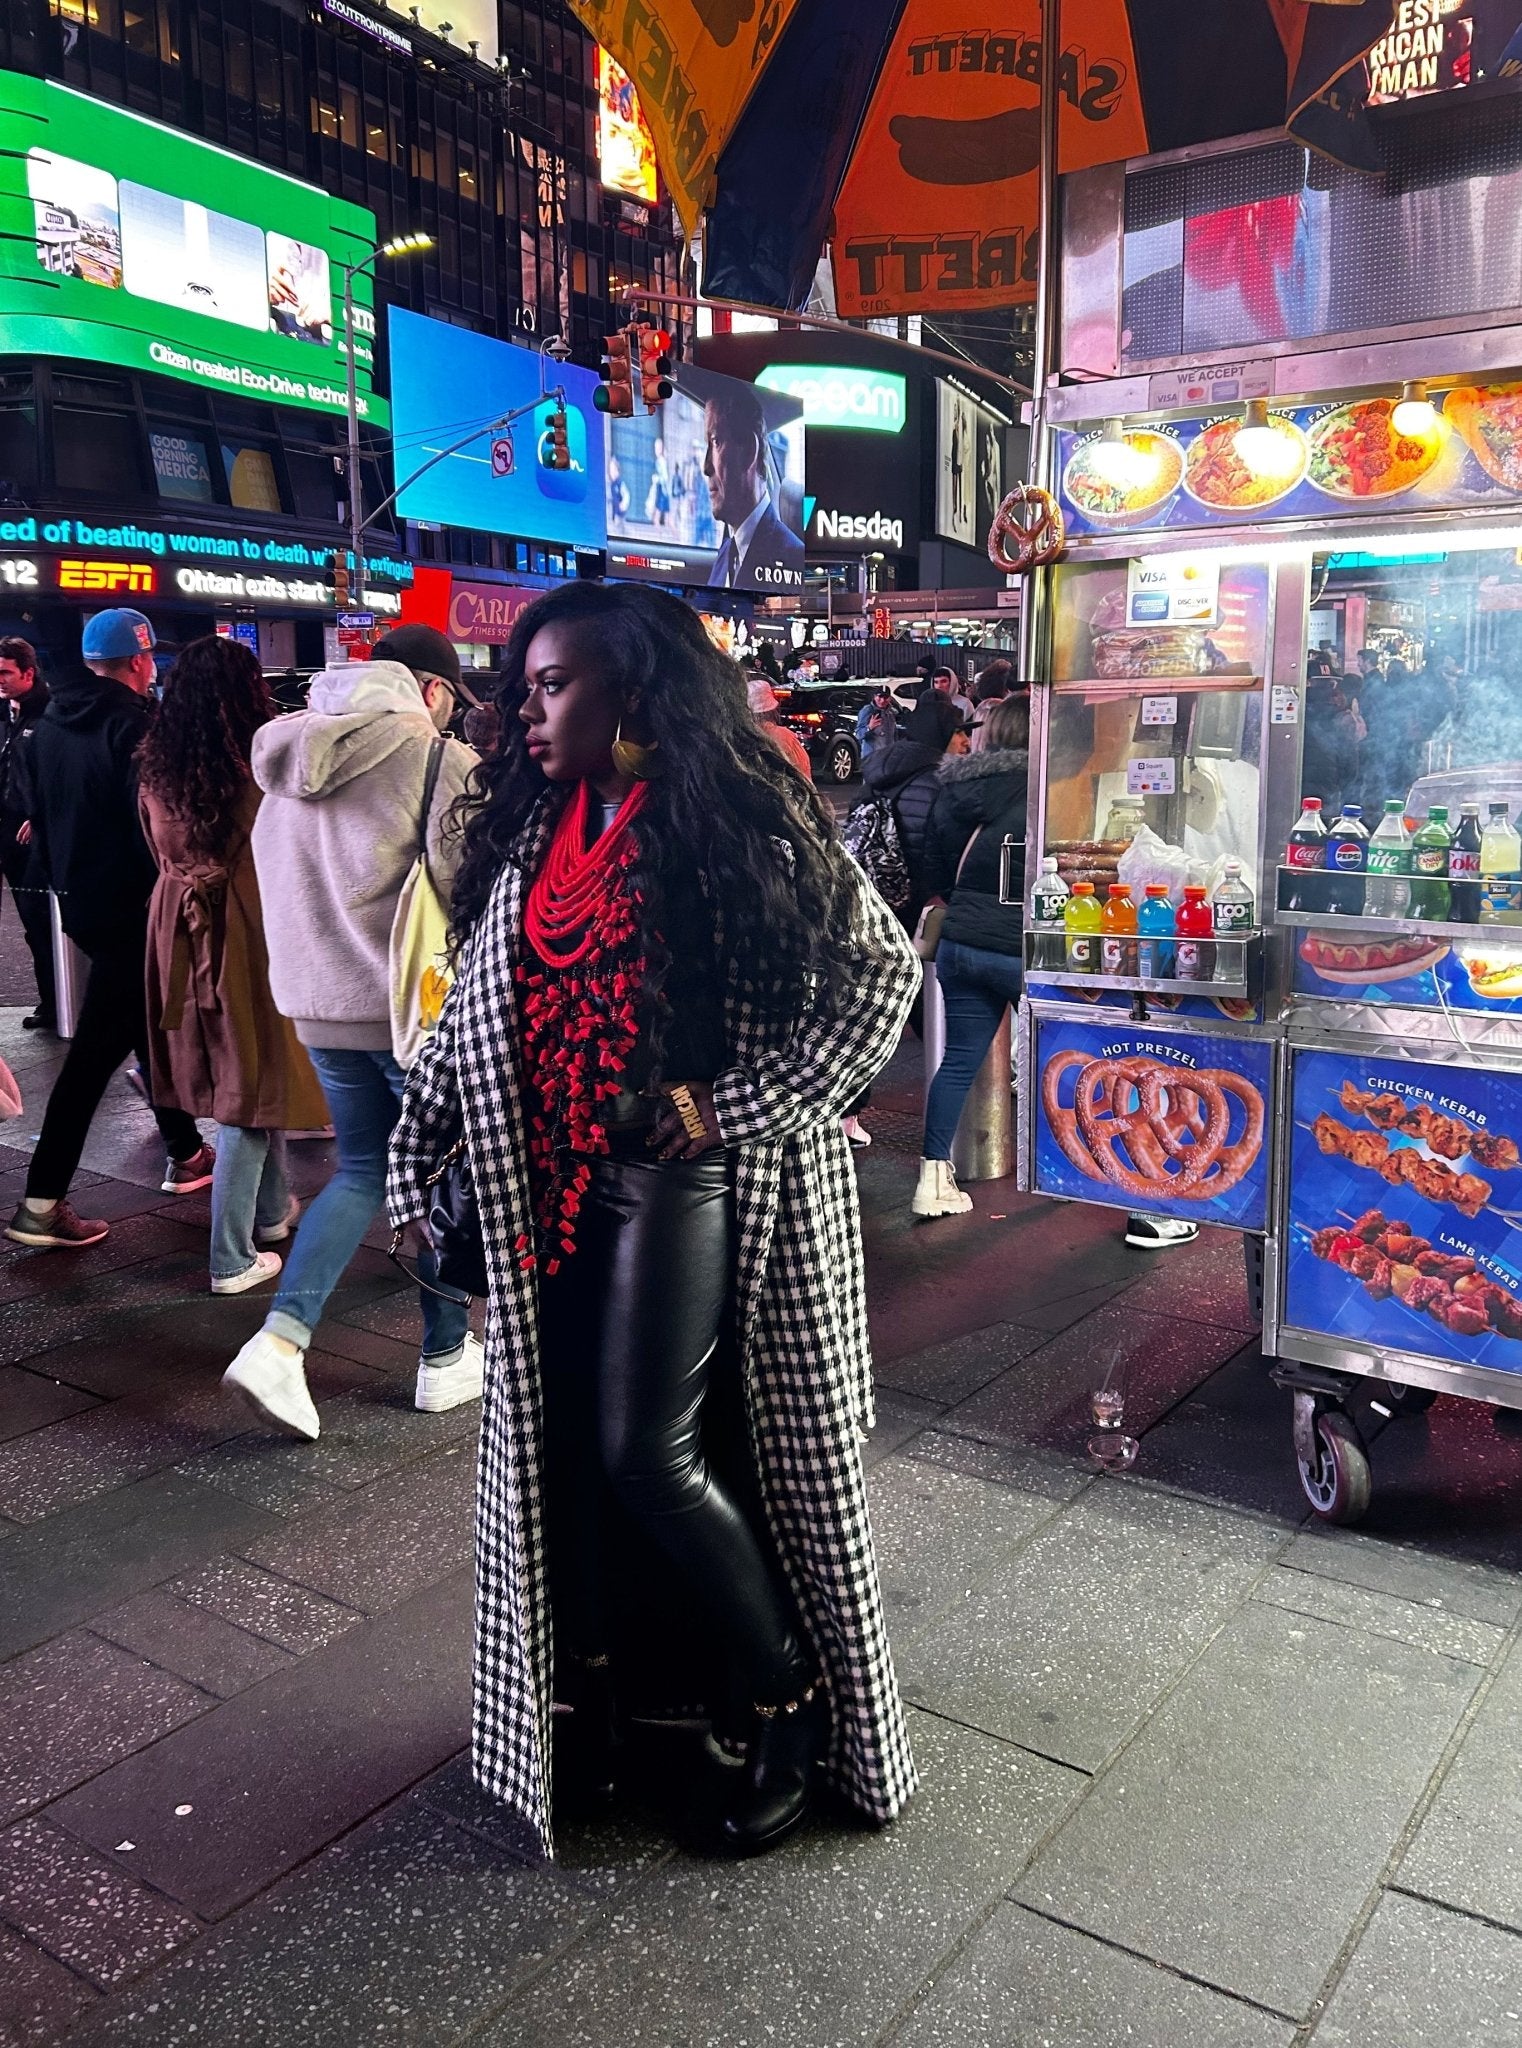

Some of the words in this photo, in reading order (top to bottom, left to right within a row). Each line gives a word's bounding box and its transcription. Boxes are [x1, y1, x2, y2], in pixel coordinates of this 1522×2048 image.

[149, 341, 191, 371] Citizen
[192, 359, 239, 384] created
[242, 367, 306, 399] Eco-Drive
[307, 382, 369, 415] technolgy.
[1177, 373, 1196, 384] WE
[1198, 366, 1246, 381] ACCEPT
[1157, 393, 1178, 402] VISA
[153, 434, 187, 451] GOOD
[1071, 428, 1104, 451] CHIC
[1153, 423, 1180, 438] RICE
[816, 509, 903, 548] Nasdaq
[43, 520, 71, 543] of
[75, 521, 165, 555] beating
[168, 533, 239, 556] woman
[243, 538, 260, 559] to
[264, 540, 309, 566] death
[1, 559, 38, 585] 12
[59, 560, 153, 591] ESPN
[177, 567, 245, 596] Ohtani
[245, 574, 287, 600] exits
[287, 580, 325, 603] start
[754, 566, 802, 586] CROWN
[1139, 572, 1167, 583] VISA
[475, 626, 496, 636] TIMES
[875, 608, 884, 639] BAR
[829, 639, 866, 647] HOTDOGS
[1072, 940, 1090, 961] G
[1103, 938, 1120, 961] G
[1102, 1042, 1130, 1057] HOT
[1136, 1042, 1197, 1069] PRETZEL
[1367, 1077, 1435, 1102] CHICKEN
[1439, 1096, 1487, 1125] KEBAB
[1440, 1232, 1476, 1257] LAMB
[1478, 1254, 1519, 1289] KEBAB
